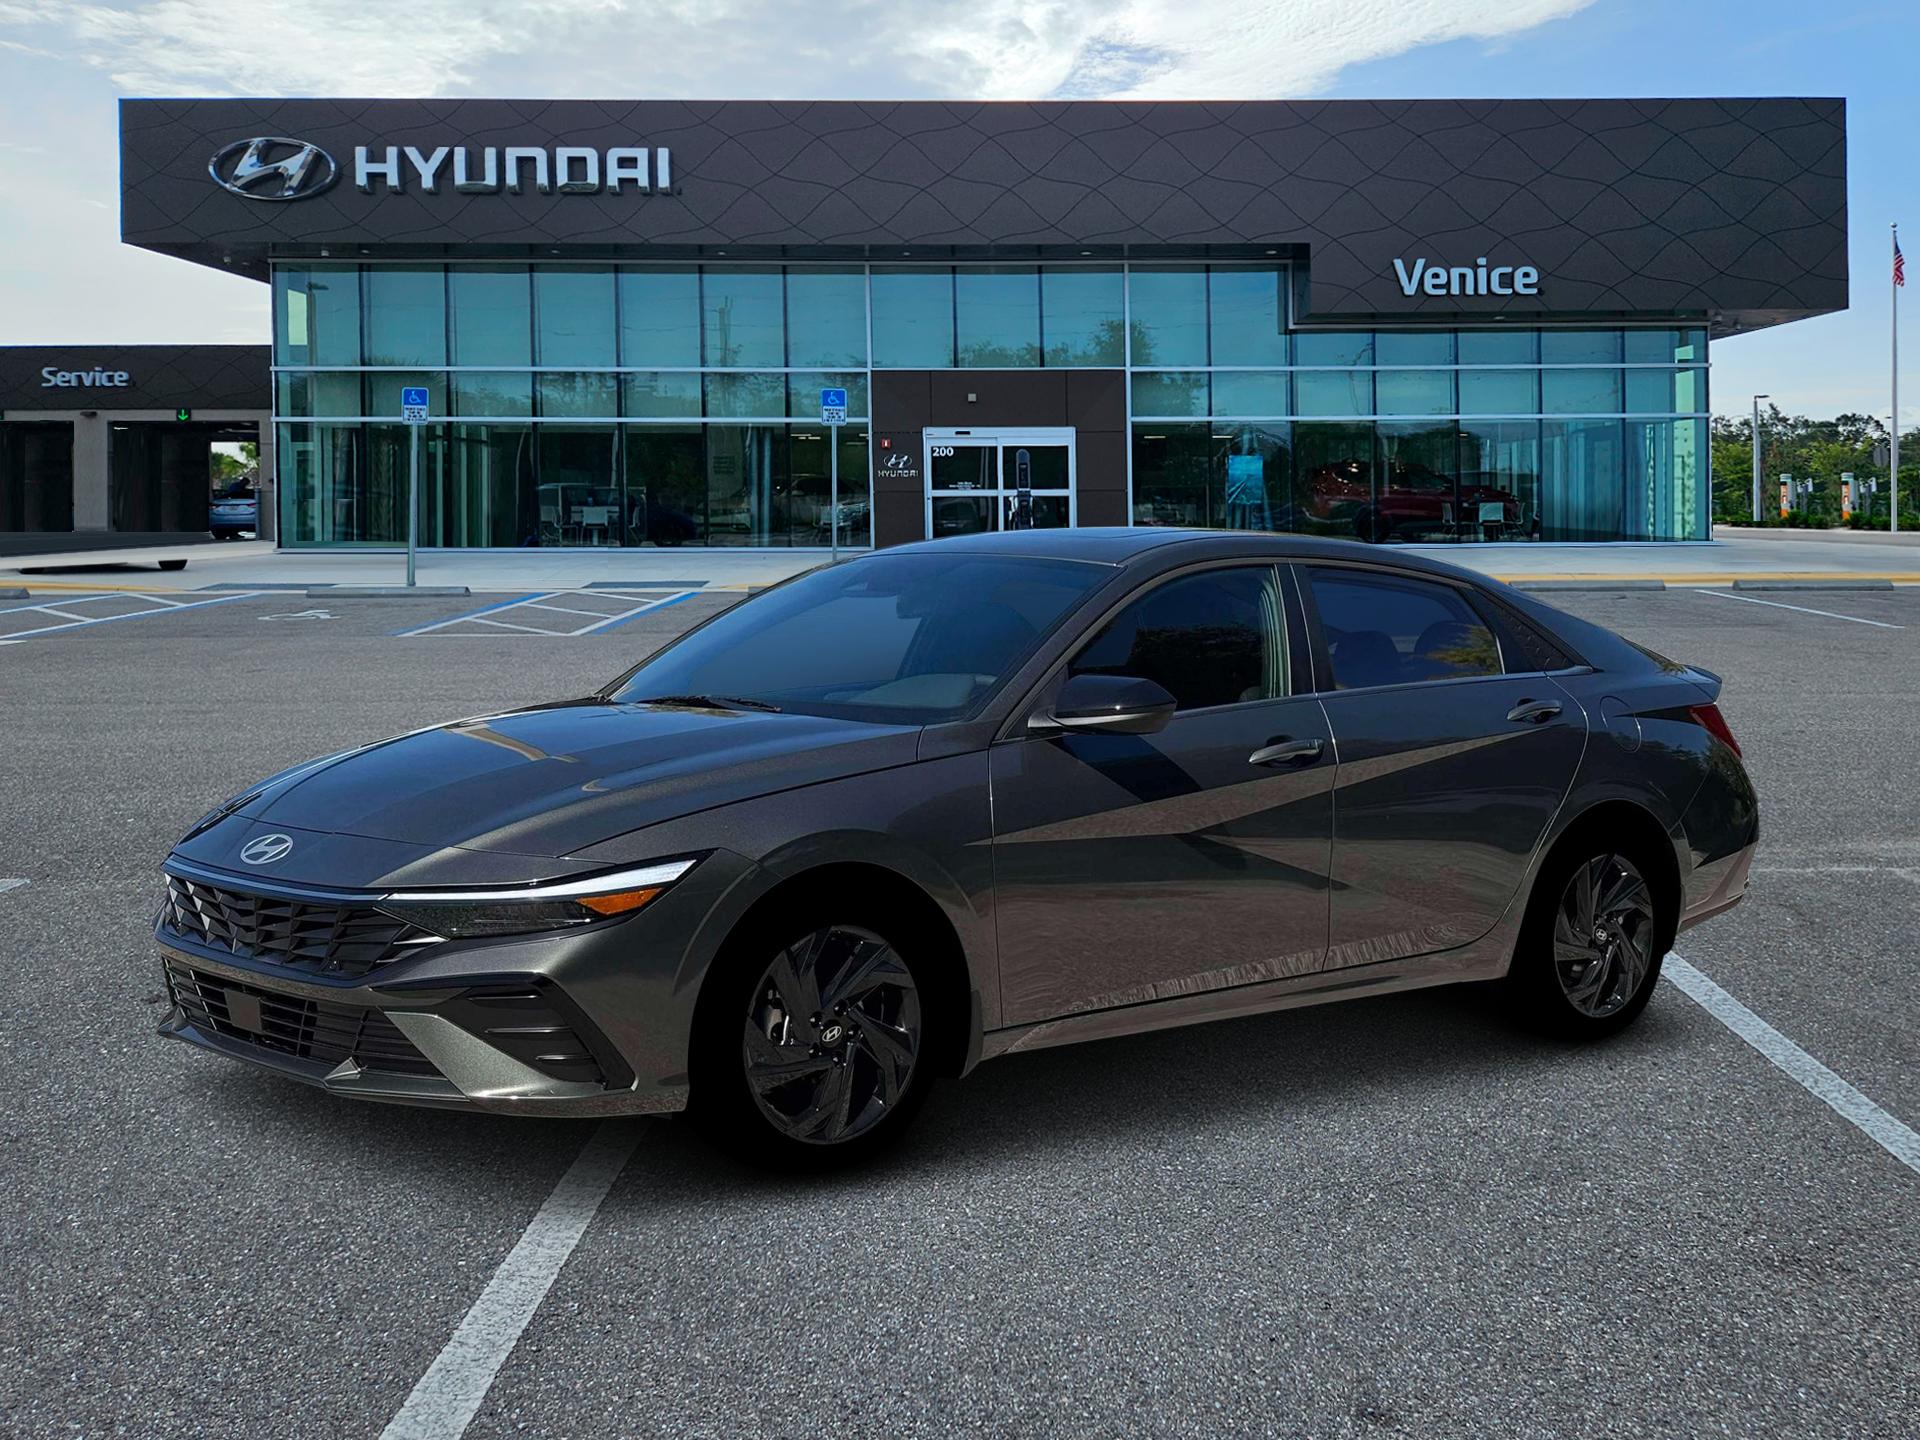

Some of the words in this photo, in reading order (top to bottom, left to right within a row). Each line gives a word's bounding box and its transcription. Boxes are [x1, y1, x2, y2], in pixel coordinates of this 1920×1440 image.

[354, 146, 672, 193] HYUNDAI
[1392, 257, 1539, 296] Venice
[41, 367, 129, 387] Service
[932, 447, 954, 457] 200
[878, 470, 919, 478] HYUNDAI
